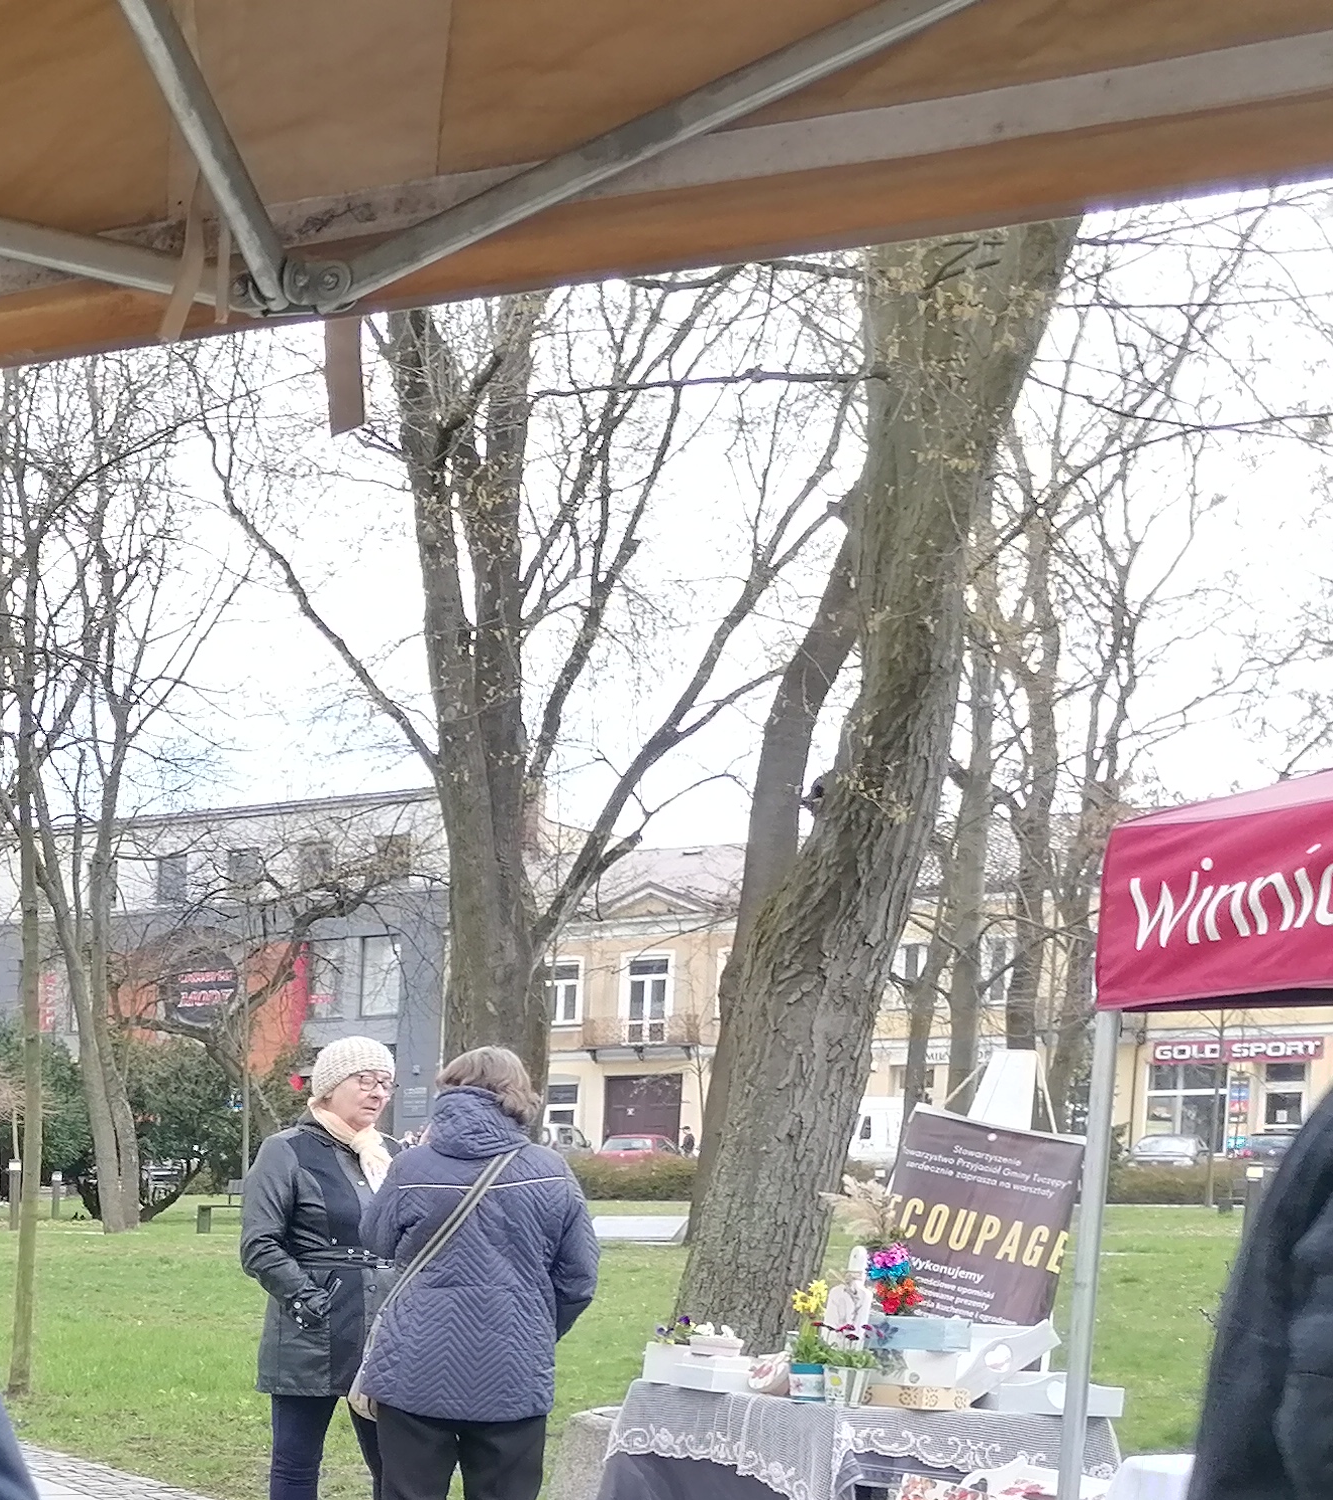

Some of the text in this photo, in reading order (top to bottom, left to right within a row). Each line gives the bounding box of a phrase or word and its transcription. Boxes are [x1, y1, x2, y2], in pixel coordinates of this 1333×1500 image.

[1129, 843, 1333, 951] Winni
[1154, 1040, 1321, 1060] GOLD SPORT
[952, 1143, 1023, 1168] Stowarzyszenie
[905, 1160, 1055, 1200] serdecznie zaprasza na warsztaty
[1002, 1167, 1031, 1182] Gminy
[891, 1193, 1069, 1275] COUPAGE
